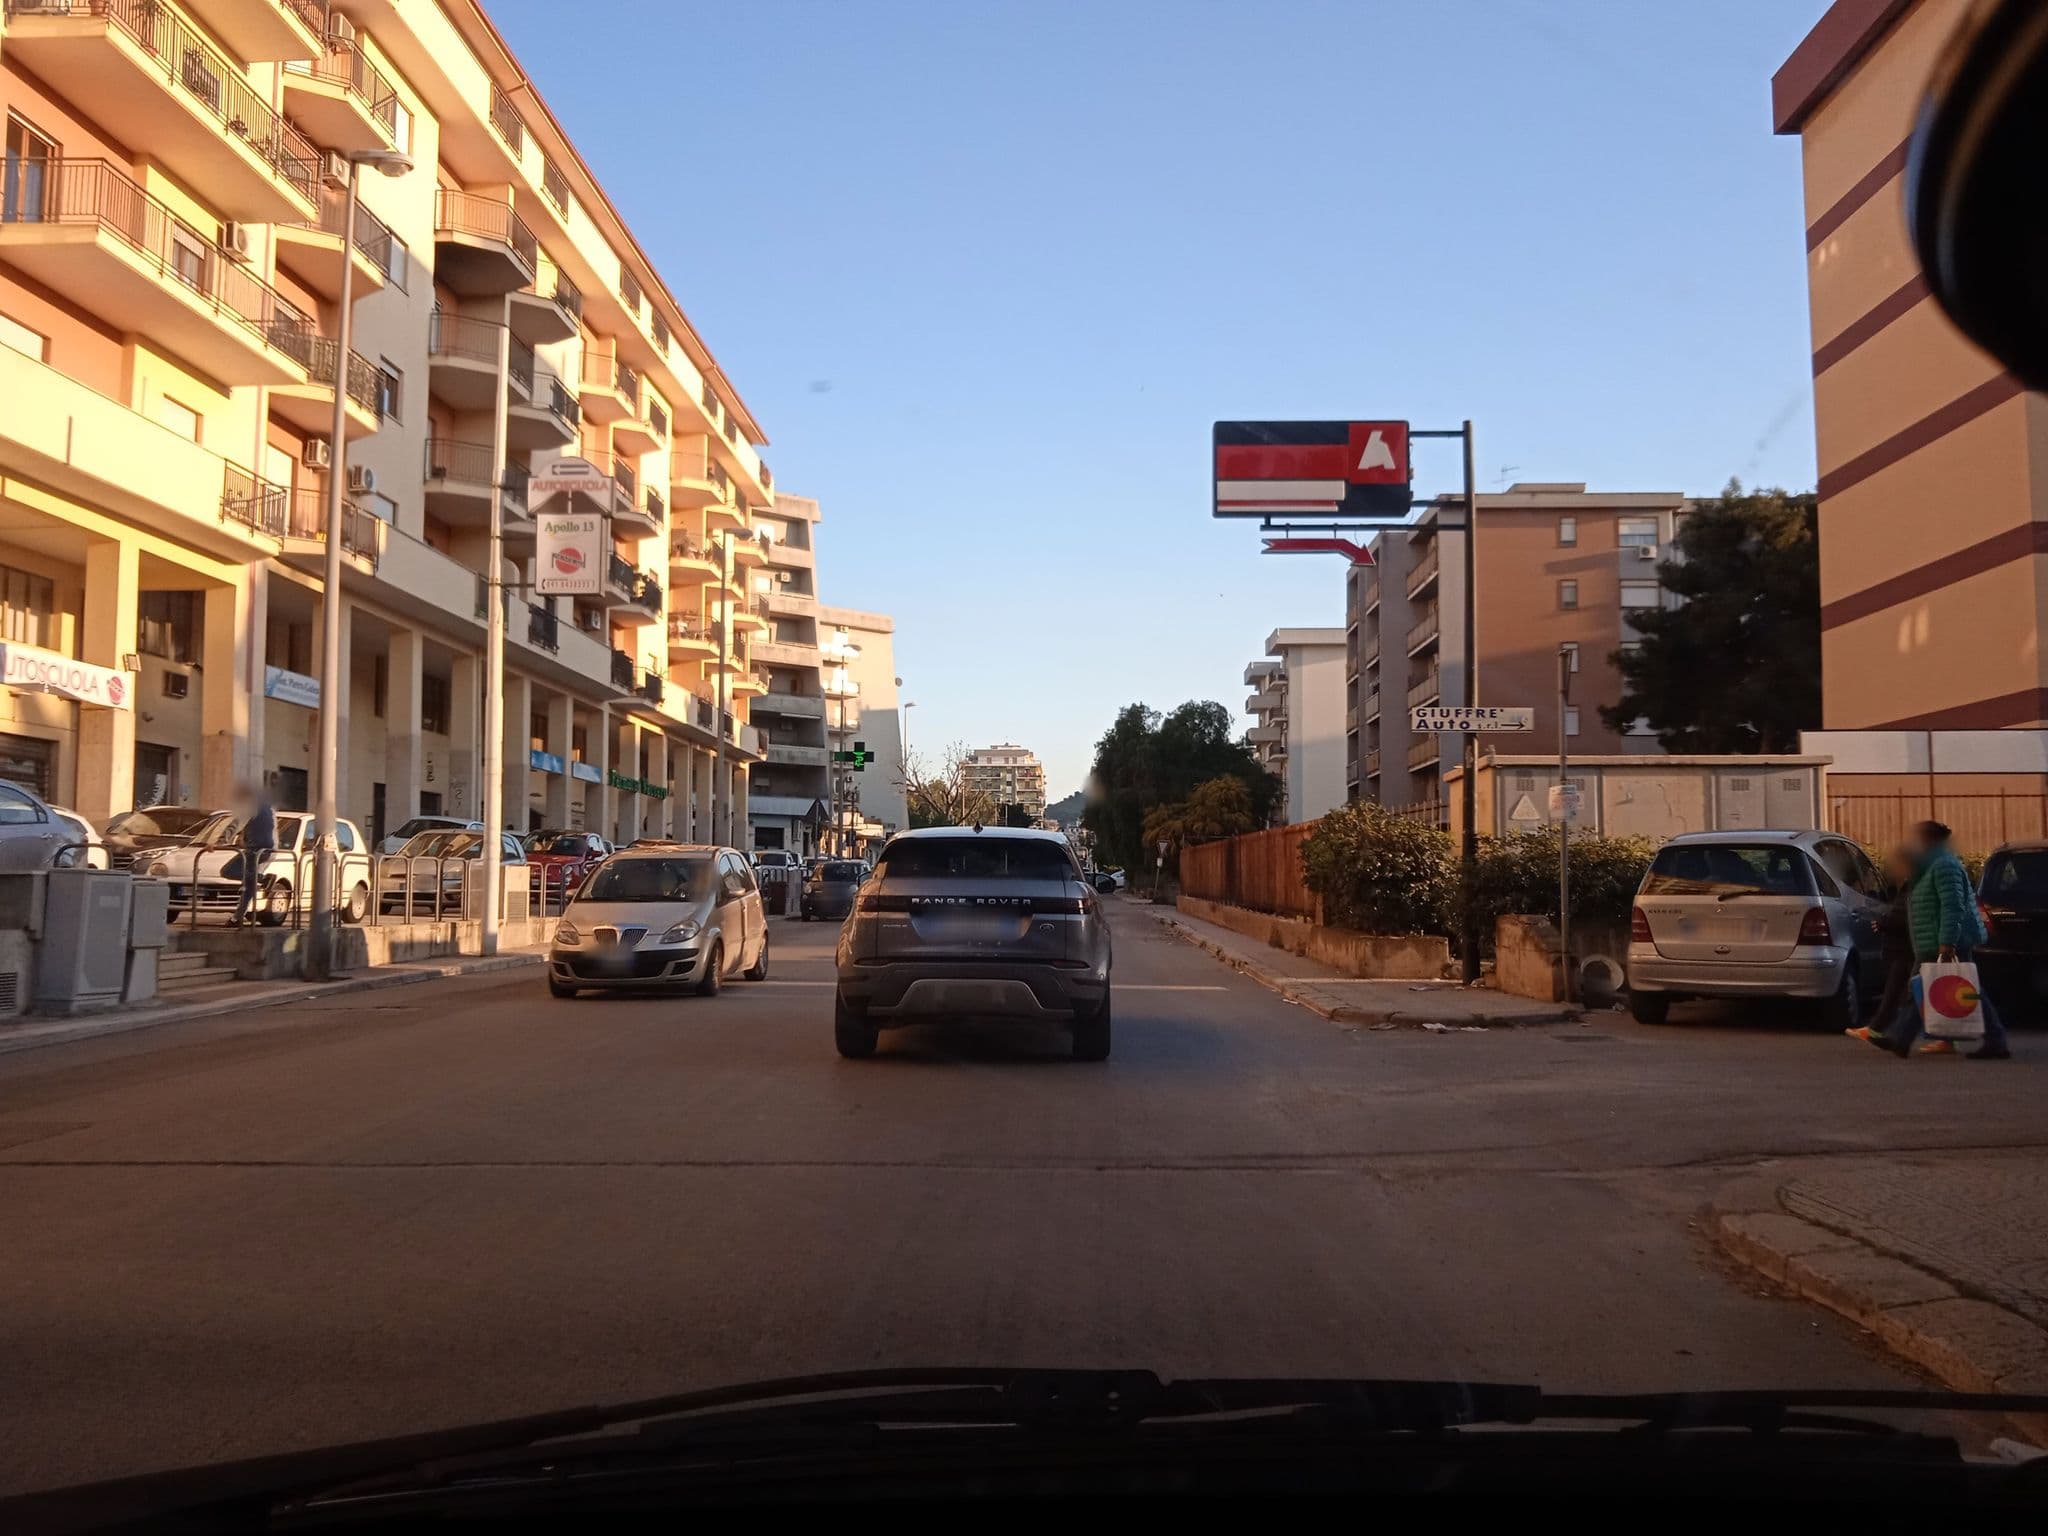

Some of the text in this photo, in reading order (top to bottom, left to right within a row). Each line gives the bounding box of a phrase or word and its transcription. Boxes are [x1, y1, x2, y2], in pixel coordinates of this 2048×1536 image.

[532, 480, 608, 491] AUTOSCUOLA
[544, 521, 595, 534] Apollo 13
[1416, 708, 1504, 718] GIUFFRE'
[1416, 719, 1502, 730] Auto s.r.l.
[911, 897, 1032, 905] RANGE ROVER
